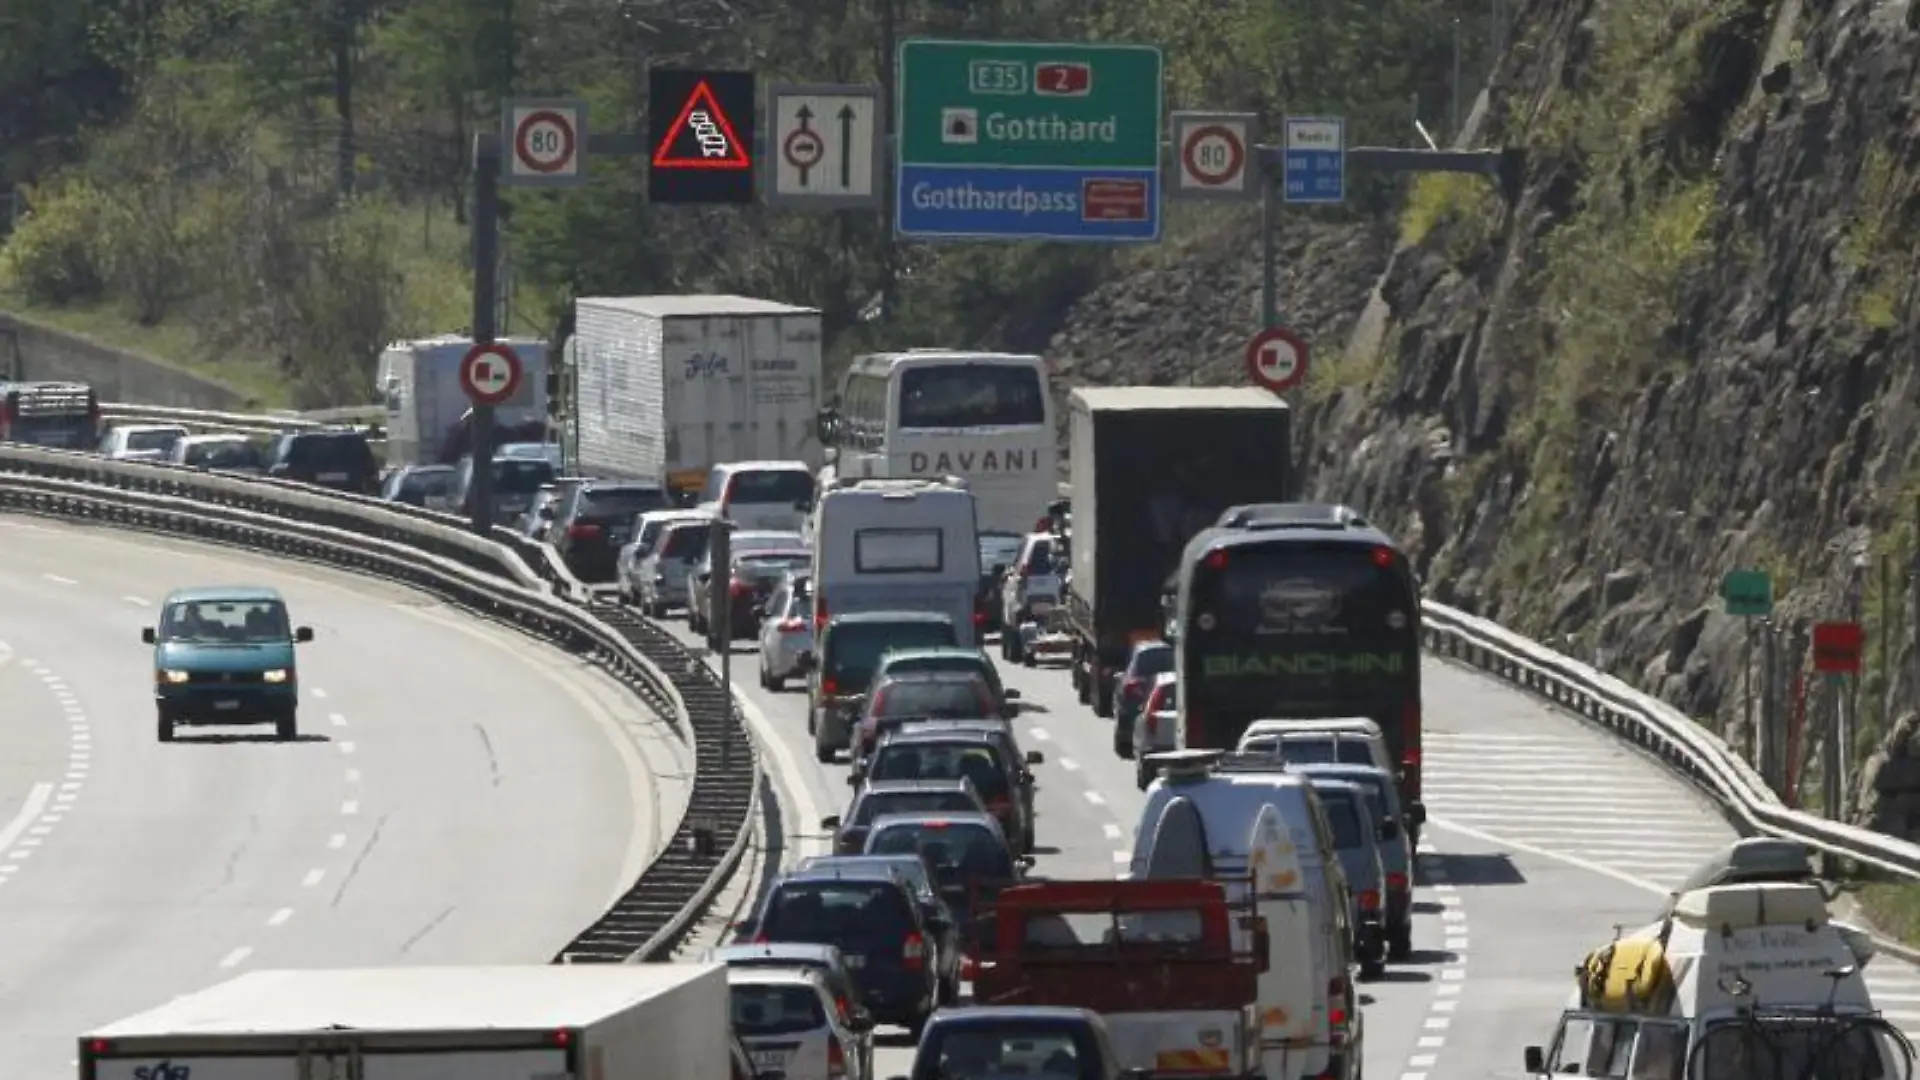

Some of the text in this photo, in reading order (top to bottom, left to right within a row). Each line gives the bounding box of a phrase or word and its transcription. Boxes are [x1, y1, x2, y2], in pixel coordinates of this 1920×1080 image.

[978, 66, 1068, 89] E35 2
[985, 112, 1116, 142] Gotthard
[532, 129, 558, 153] 80
[1202, 145, 1224, 167] 80
[911, 182, 1077, 216] Gotthardpass
[910, 449, 1038, 473] DAVANI
[1204, 653, 1403, 676] BIANCHINI
